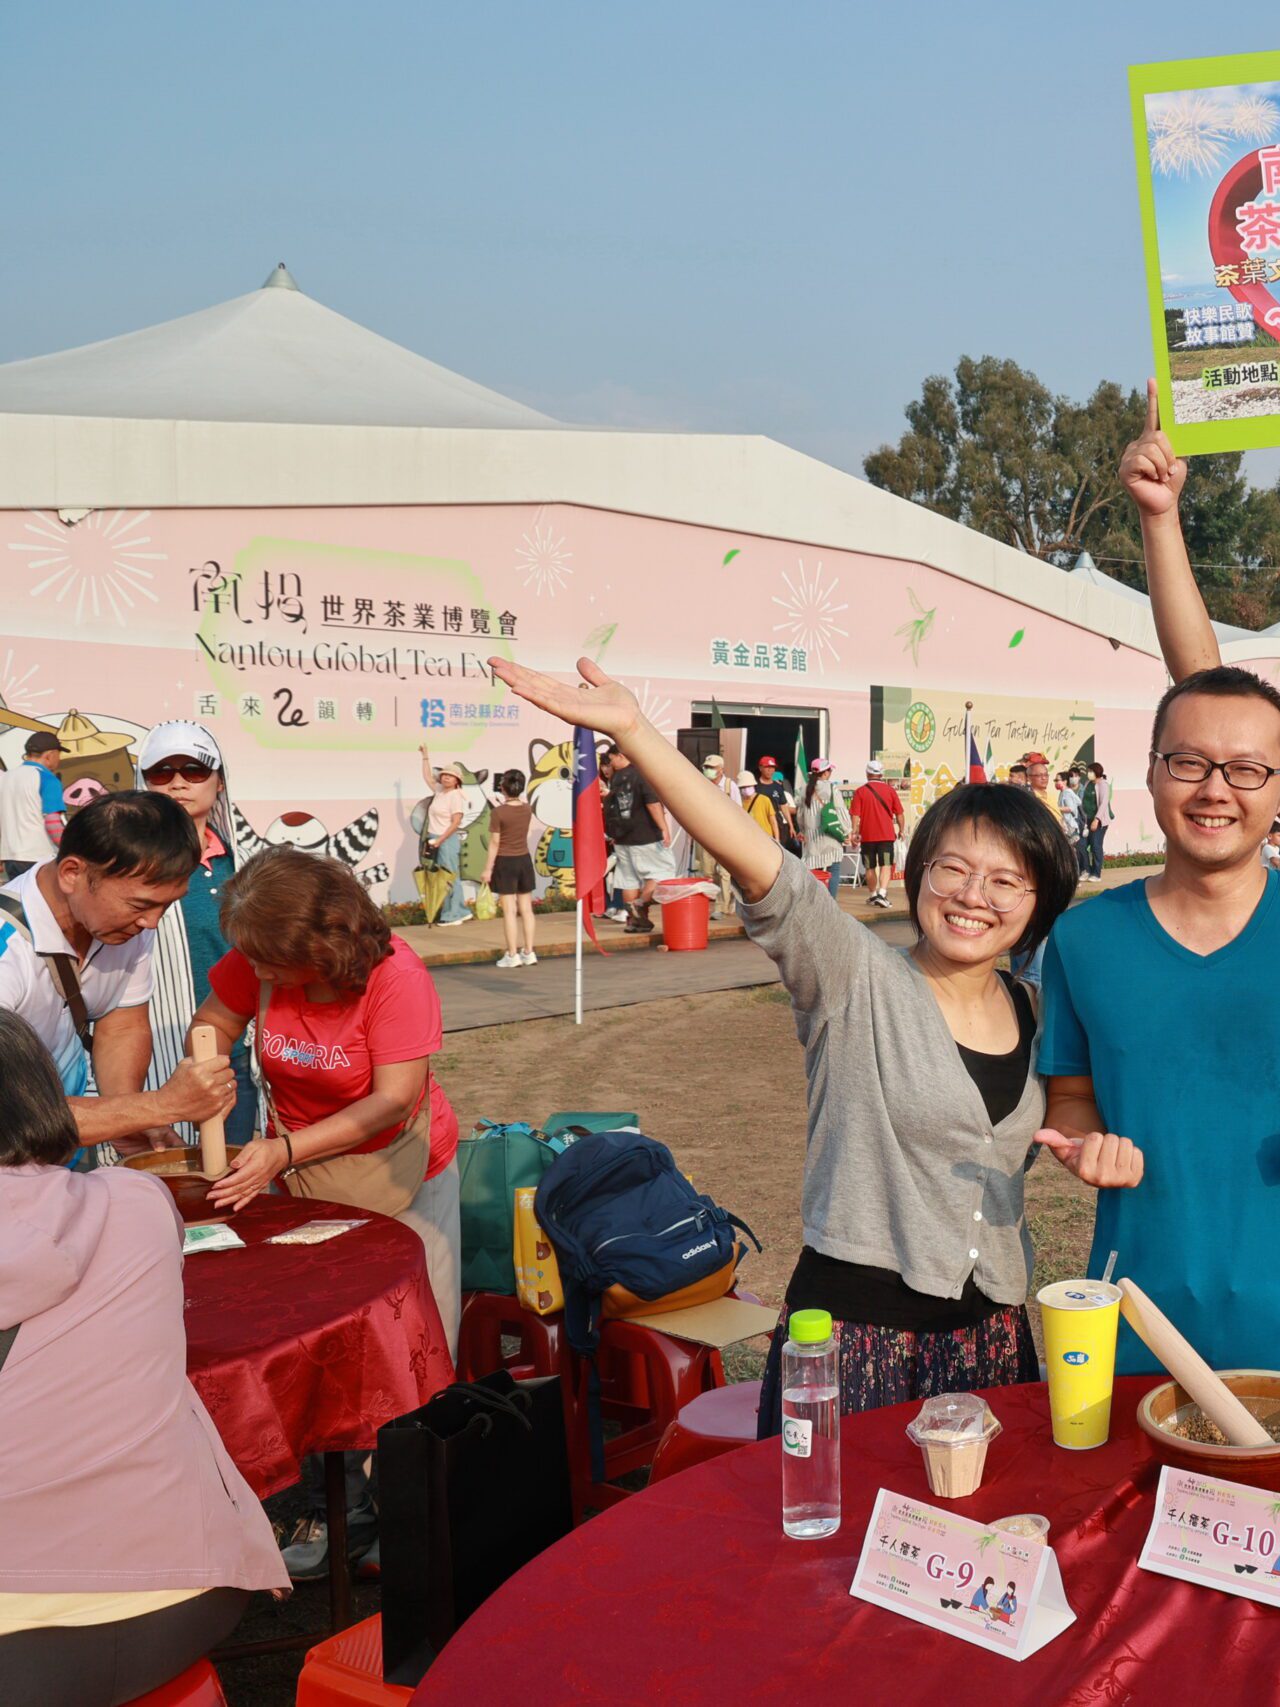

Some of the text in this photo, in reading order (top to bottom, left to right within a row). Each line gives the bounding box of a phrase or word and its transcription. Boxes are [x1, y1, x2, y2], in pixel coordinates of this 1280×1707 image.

[1184, 303, 1253, 325] 快樂民歌
[320, 595, 518, 636] 世界茶業博覽會
[195, 633, 312, 675] Nantou
[313, 642, 407, 680] Global
[406, 648, 452, 677] Tea
[711, 640, 807, 673] 黃金品茗館
[942, 717, 980, 741] Golen
[985, 719, 1001, 739] Tea
[1005, 720, 1039, 745] Tasting
[1042, 721, 1070, 743] House
[682, 1242, 712, 1260] adidas
[1212, 1521, 1275, 1557] G-10
[925, 1554, 974, 1588] G-9
